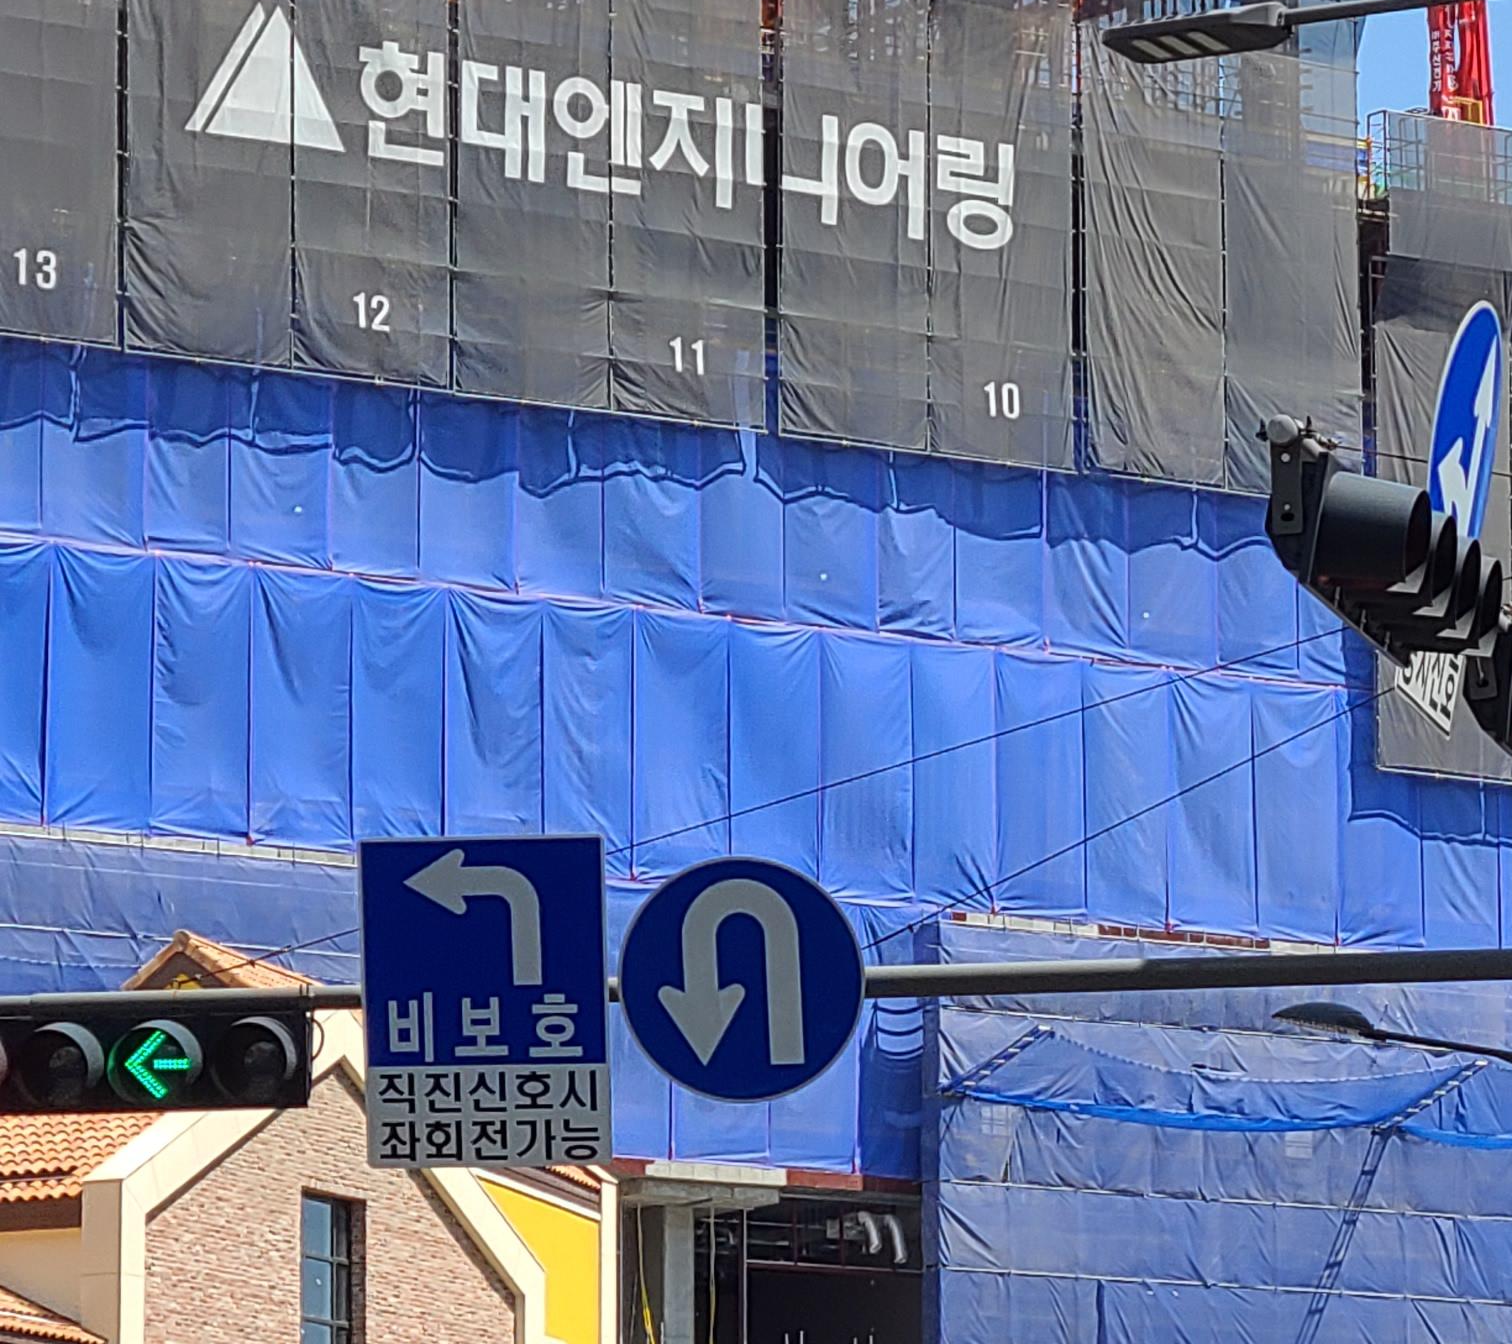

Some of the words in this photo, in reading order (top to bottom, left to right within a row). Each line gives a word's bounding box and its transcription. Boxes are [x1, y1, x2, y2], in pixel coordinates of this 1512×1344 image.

[357, 41, 1016, 250] 현대엔지니어링
[14, 249, 57, 290] 13
[353, 292, 391, 333] 12
[669, 337, 706, 376] 11
[984, 381, 1020, 421] 10
[388, 990, 584, 1063] 비보호
[378, 1069, 599, 1113] 직진신호시
[380, 1118, 600, 1162] 좌회전가능
